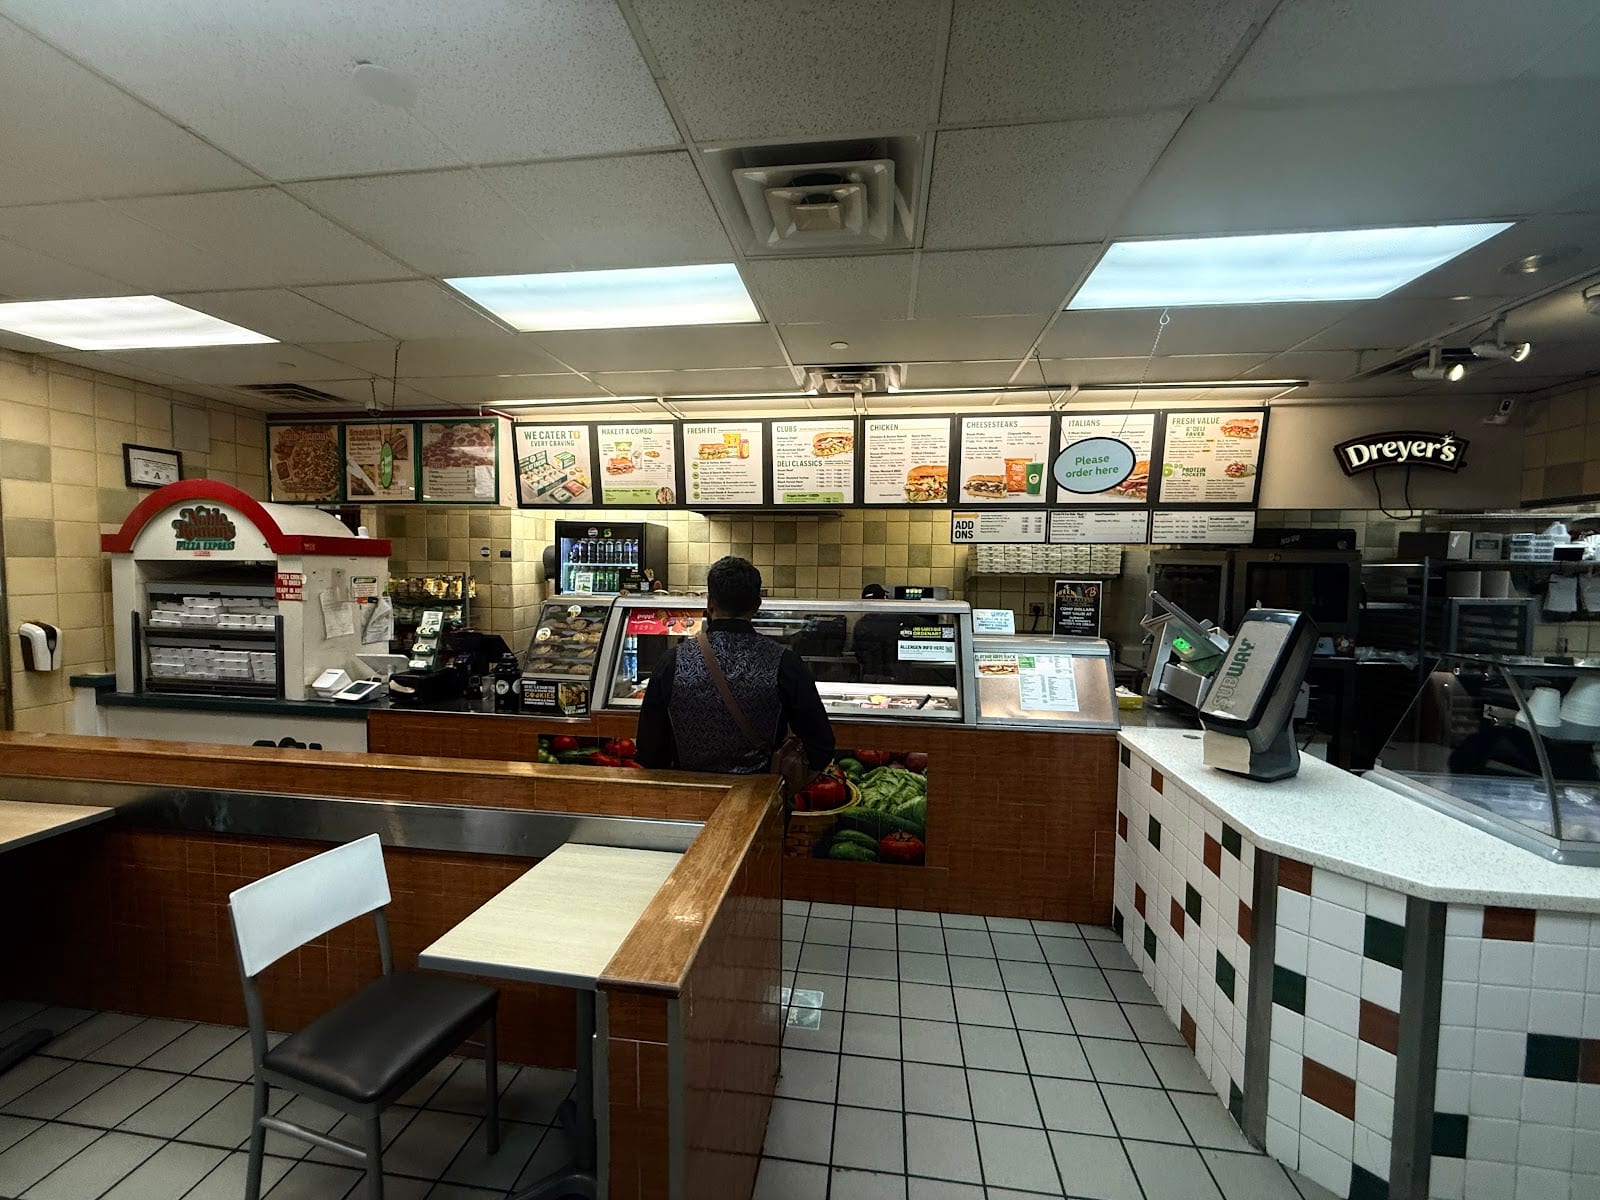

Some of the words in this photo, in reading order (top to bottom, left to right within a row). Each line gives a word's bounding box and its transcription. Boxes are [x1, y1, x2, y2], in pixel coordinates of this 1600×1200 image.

[966, 420, 1018, 429] CHEESESTEAKS
[1068, 419, 1101, 427] ITALIANS
[1172, 417, 1195, 425] FRESH
[776, 425, 798, 433] CLUBS
[524, 431, 537, 440] WE
[538, 430, 567, 440] CATER
[568, 430, 581, 440] TO
[1345, 437, 1457, 467] Dreyer's
[777, 460, 791, 468] DELI
[791, 460, 823, 468] CLASSICS
[1075, 455, 1110, 466] Please
[1065, 467, 1093, 478] order
[1095, 465, 1119, 475] here
[954, 520, 974, 530] ADD
[954, 530, 974, 539] ONS
[1212, 637, 1256, 710] SUBWAY
